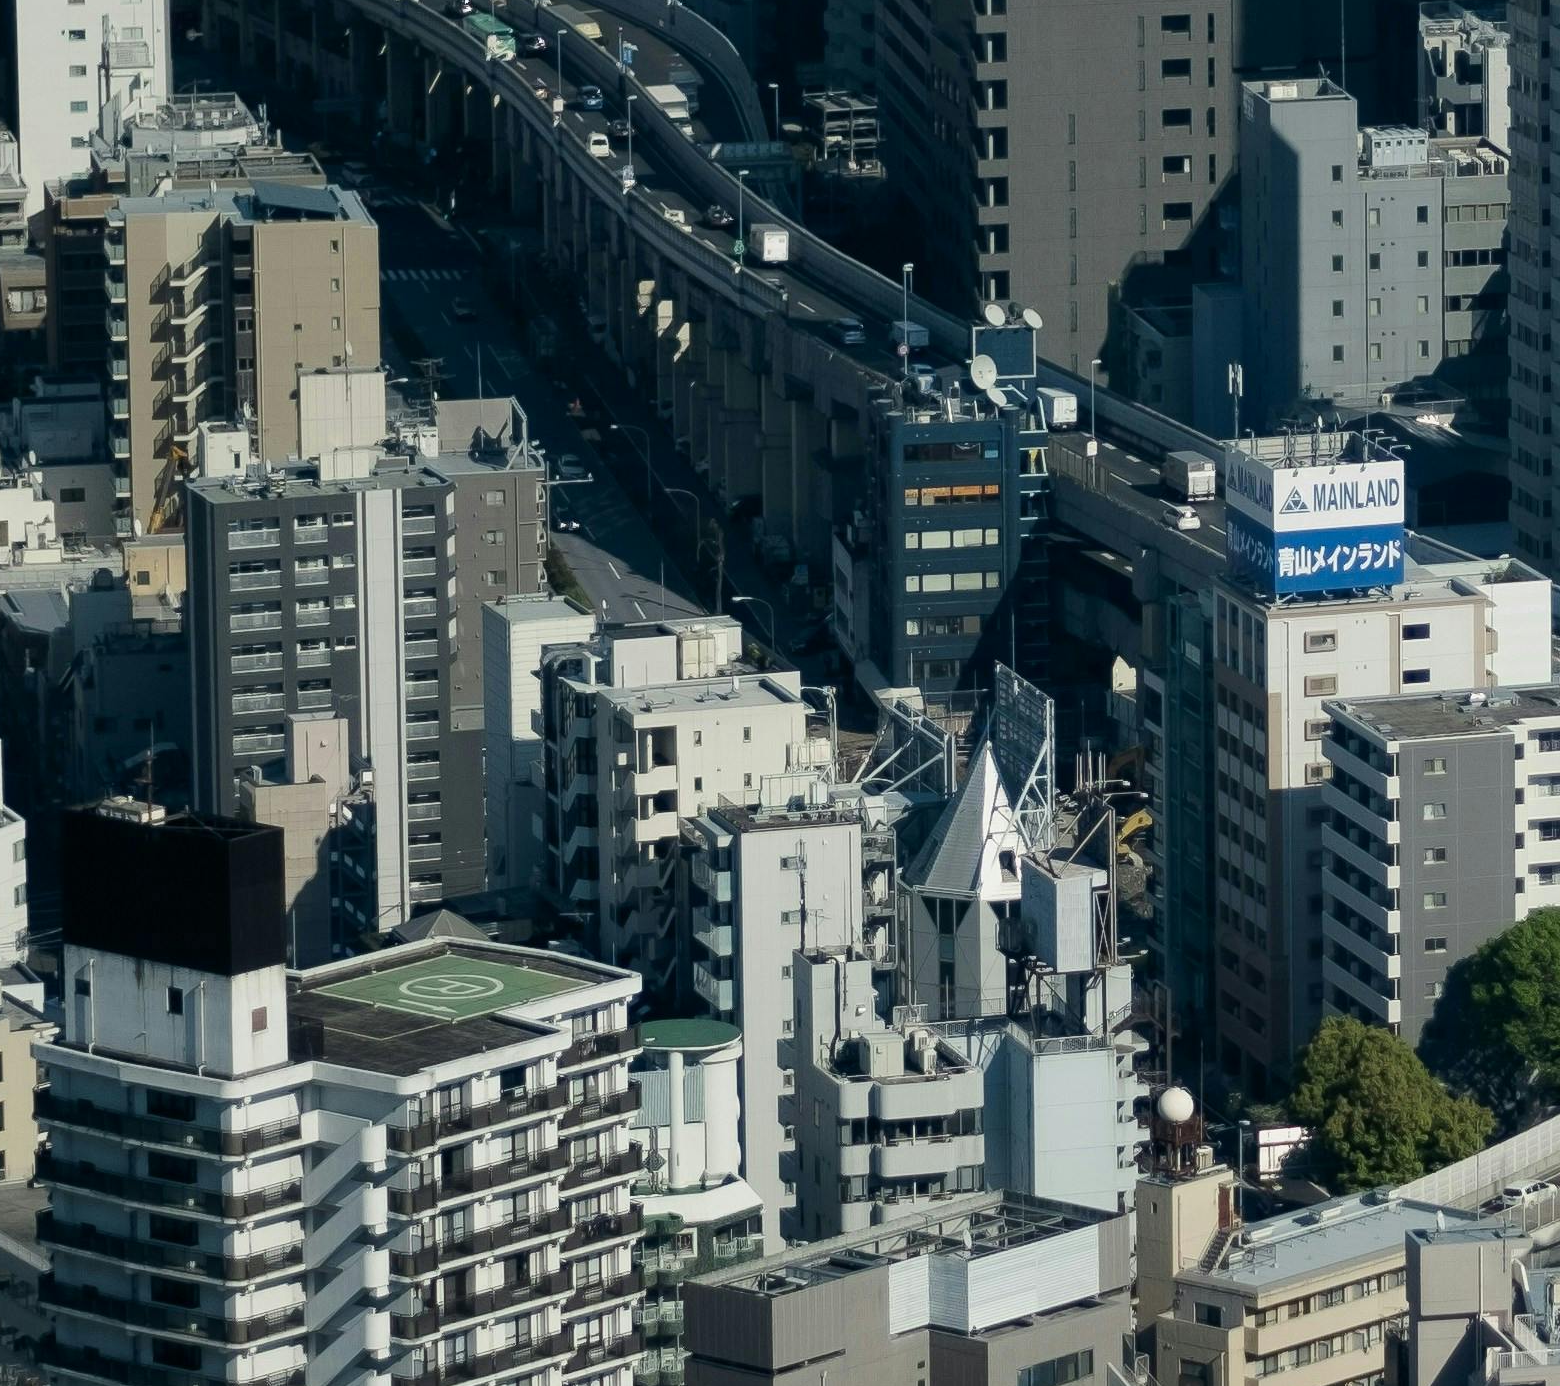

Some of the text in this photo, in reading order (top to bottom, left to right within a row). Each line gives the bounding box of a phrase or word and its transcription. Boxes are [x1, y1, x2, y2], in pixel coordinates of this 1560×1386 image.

[1313, 478, 1400, 512] MAINLAND
[1278, 540, 1401, 577] 青山メインランド
